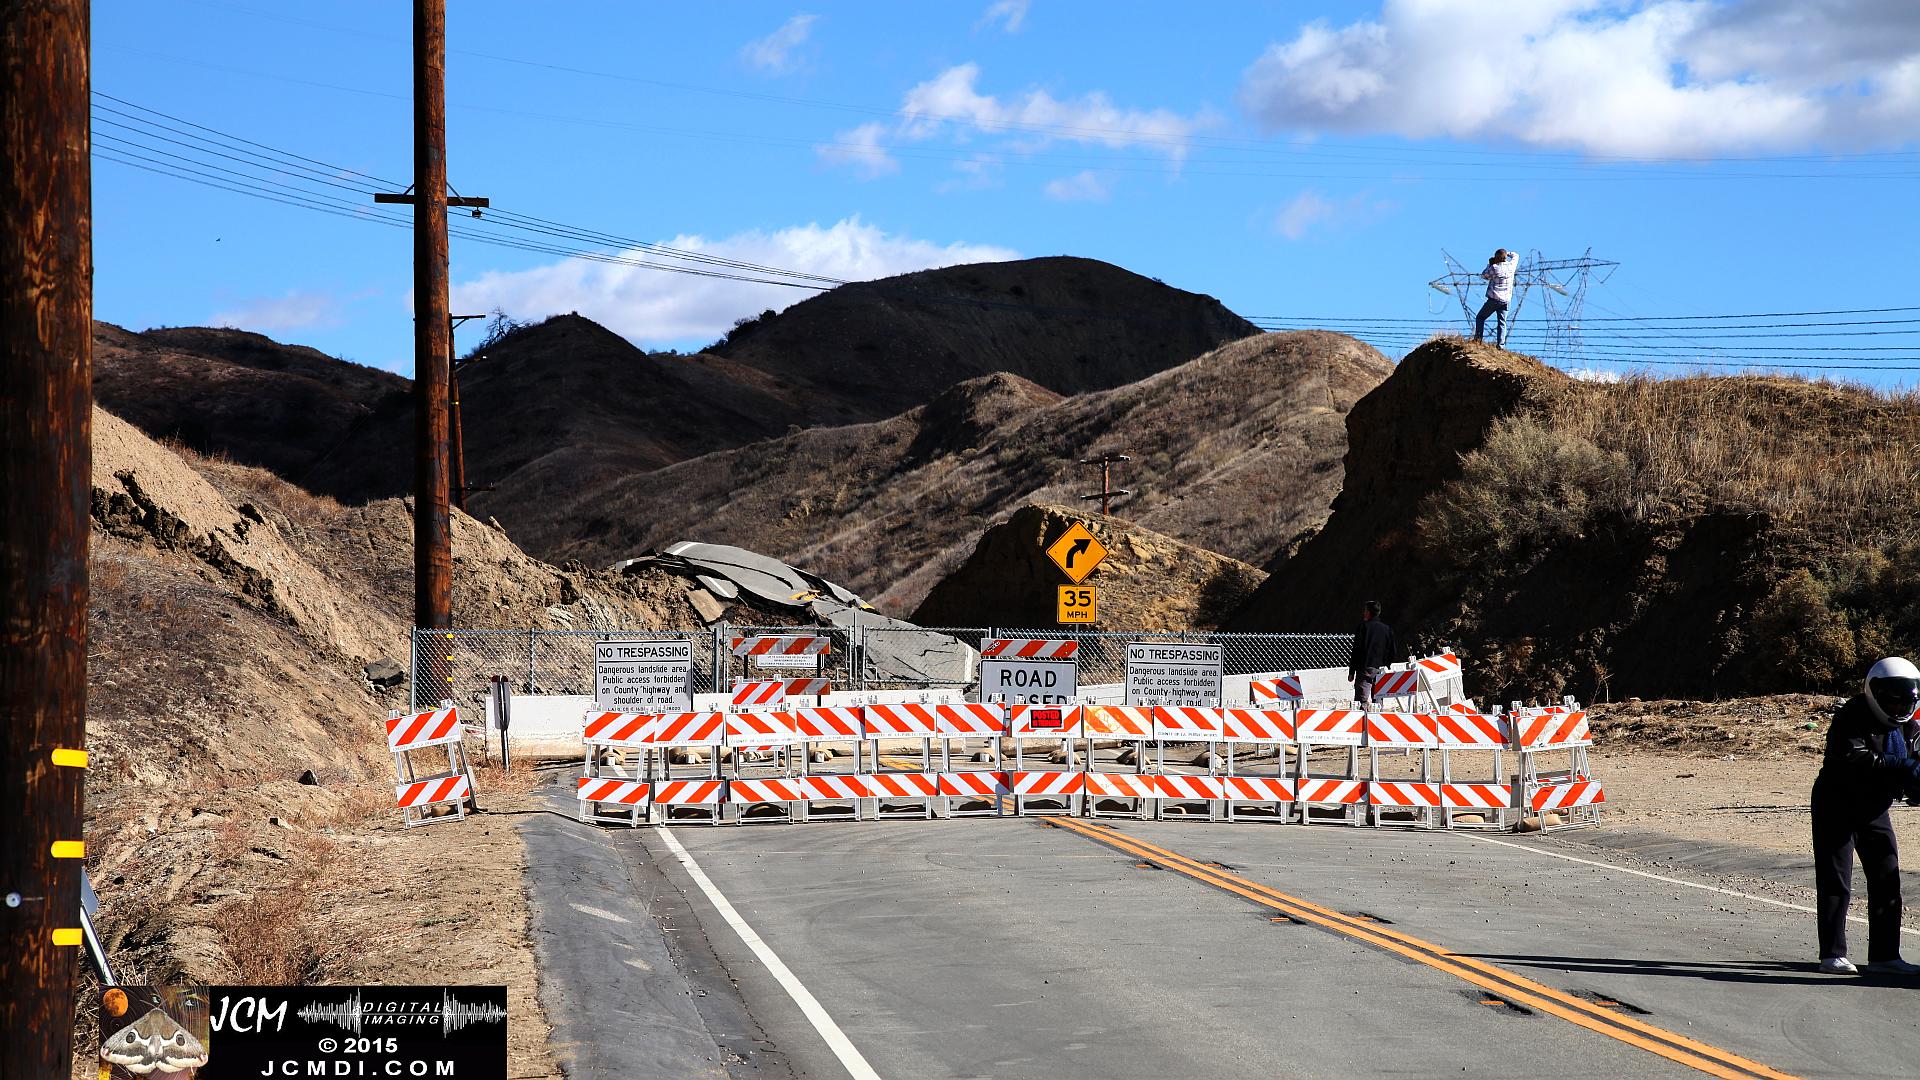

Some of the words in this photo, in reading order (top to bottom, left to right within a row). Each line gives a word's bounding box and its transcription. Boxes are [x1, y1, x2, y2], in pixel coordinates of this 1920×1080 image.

[1063, 590, 1091, 607] 35
[598, 647, 613, 658] NO
[616, 646, 689, 658] TRESPASSING
[1130, 648, 1145, 659] NO
[1148, 649, 1219, 661] TRESPASSING
[598, 665, 635, 675] Dangerous
[638, 665, 668, 673] landslide
[1129, 666, 1165, 677] Dangerous
[1168, 667, 1198, 676] landslide
[1201, 669, 1219, 677] area.
[602, 676, 623, 684] Public
[654, 675, 686, 683] forbidden
[1000, 669, 1057, 687] ROAD
[1133, 677, 1154, 685] Public
[1184, 678, 1215, 687] forbidden
[613, 686, 639, 695] County
[642, 685, 671, 695] highway
[674, 685, 687, 693] and
[1143, 687, 1169, 696] County
[1172, 688, 1200, 698] highway
[1203, 689, 1216, 697] and
[613, 696, 643, 704] shoulder
[647, 695, 655, 704] of
[657, 696, 675, 704] road.
[987, 693, 1068, 705] SED
[1032, 710, 1060, 719] POSTED
